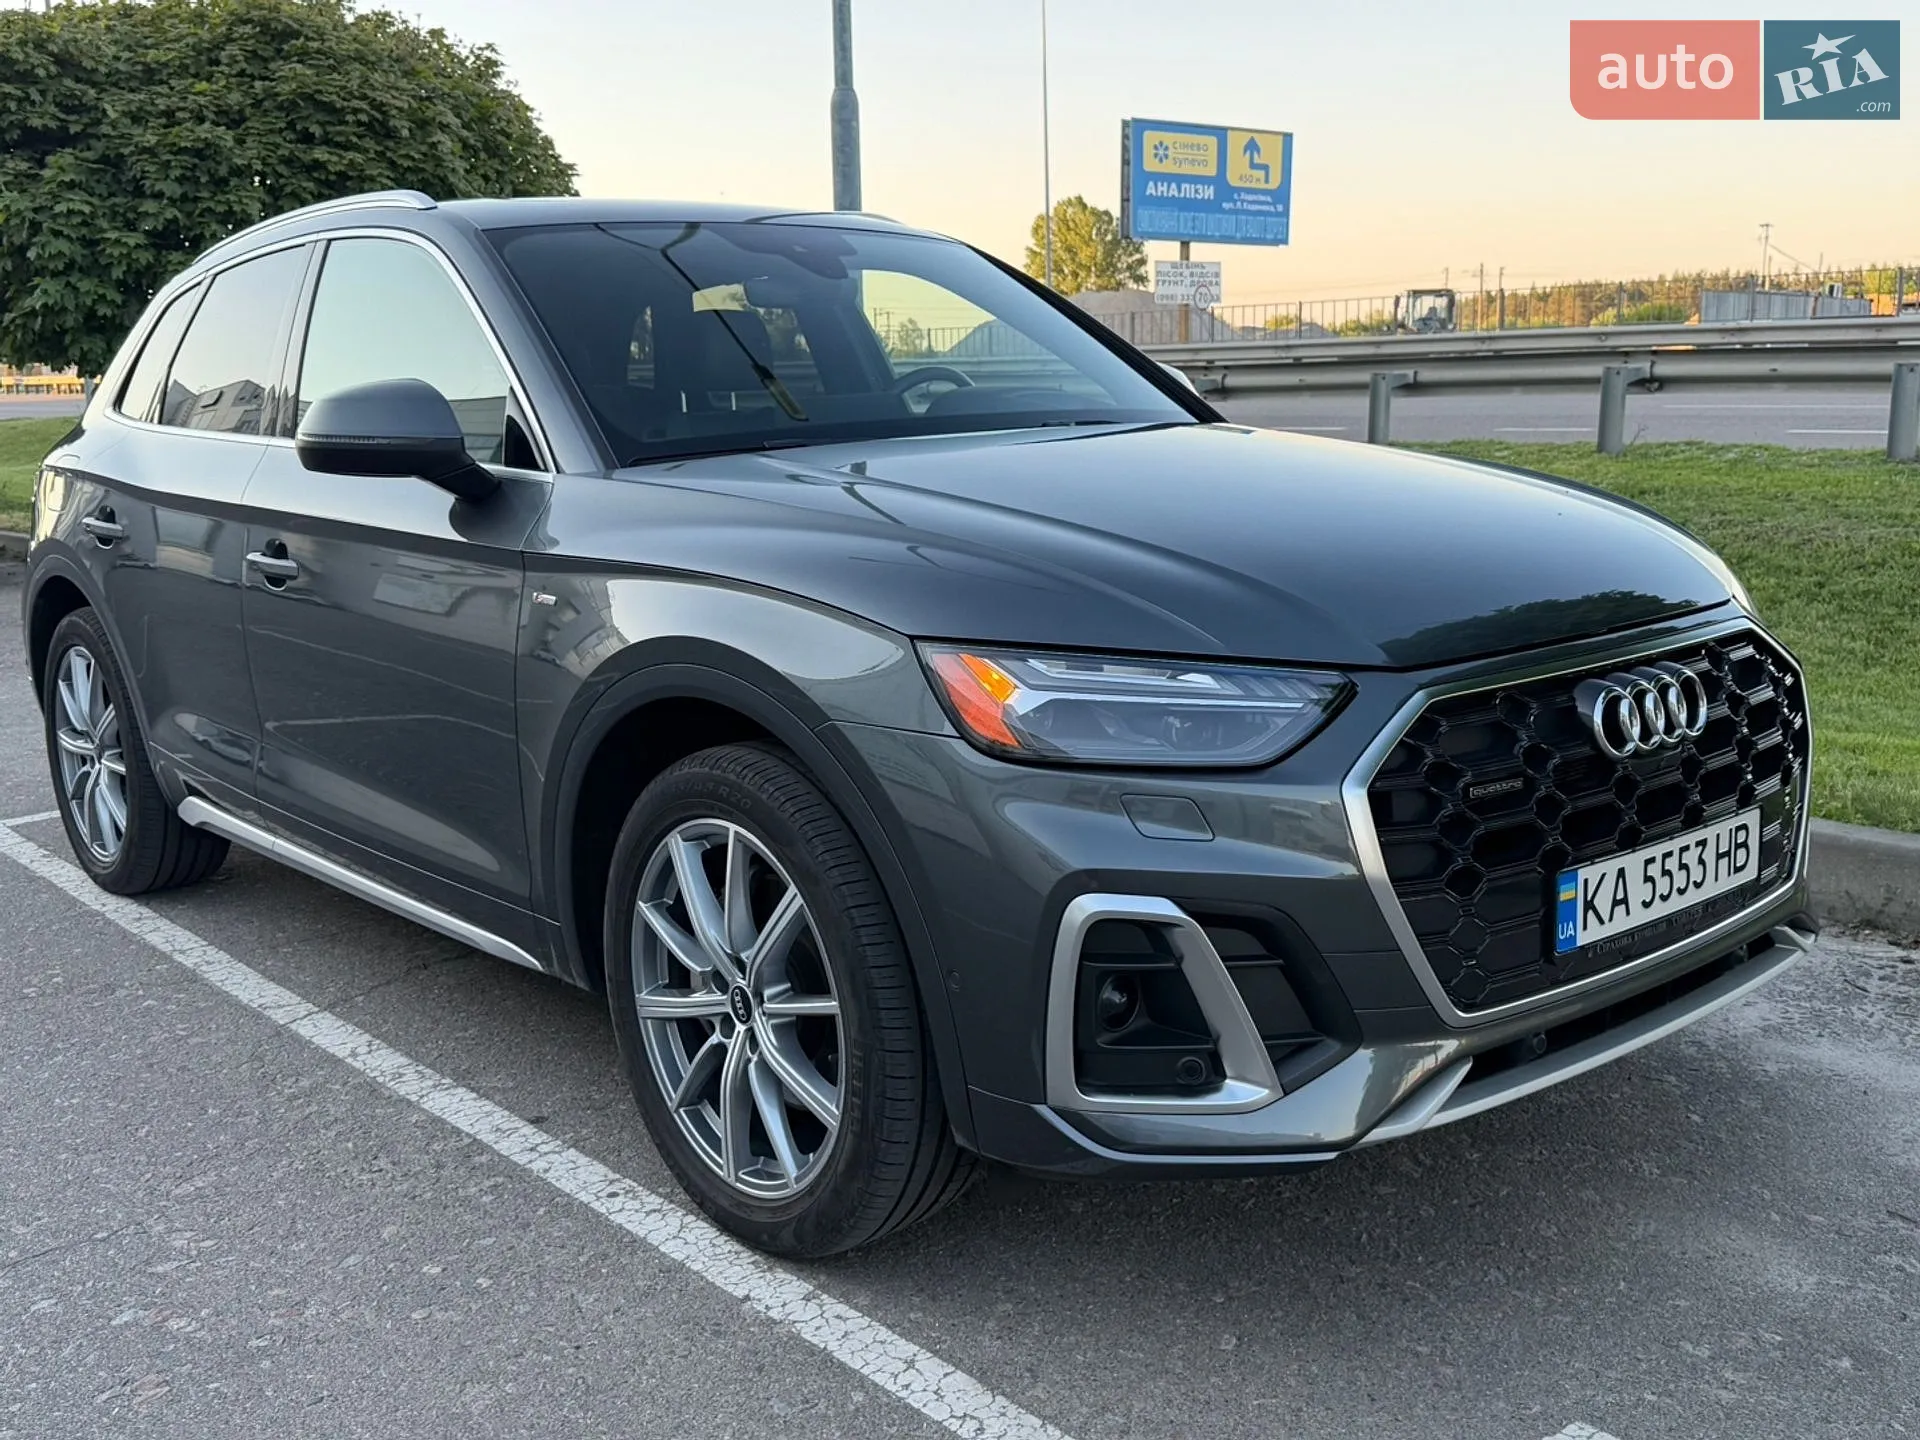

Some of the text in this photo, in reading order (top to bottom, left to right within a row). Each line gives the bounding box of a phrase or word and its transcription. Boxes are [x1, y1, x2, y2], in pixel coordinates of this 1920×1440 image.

[1172, 156, 1209, 169] synevo
[1145, 181, 1215, 201] АНАЛІЗИ
[1582, 822, 1750, 931] KA 5553 HB
[1558, 921, 1575, 940] UA
